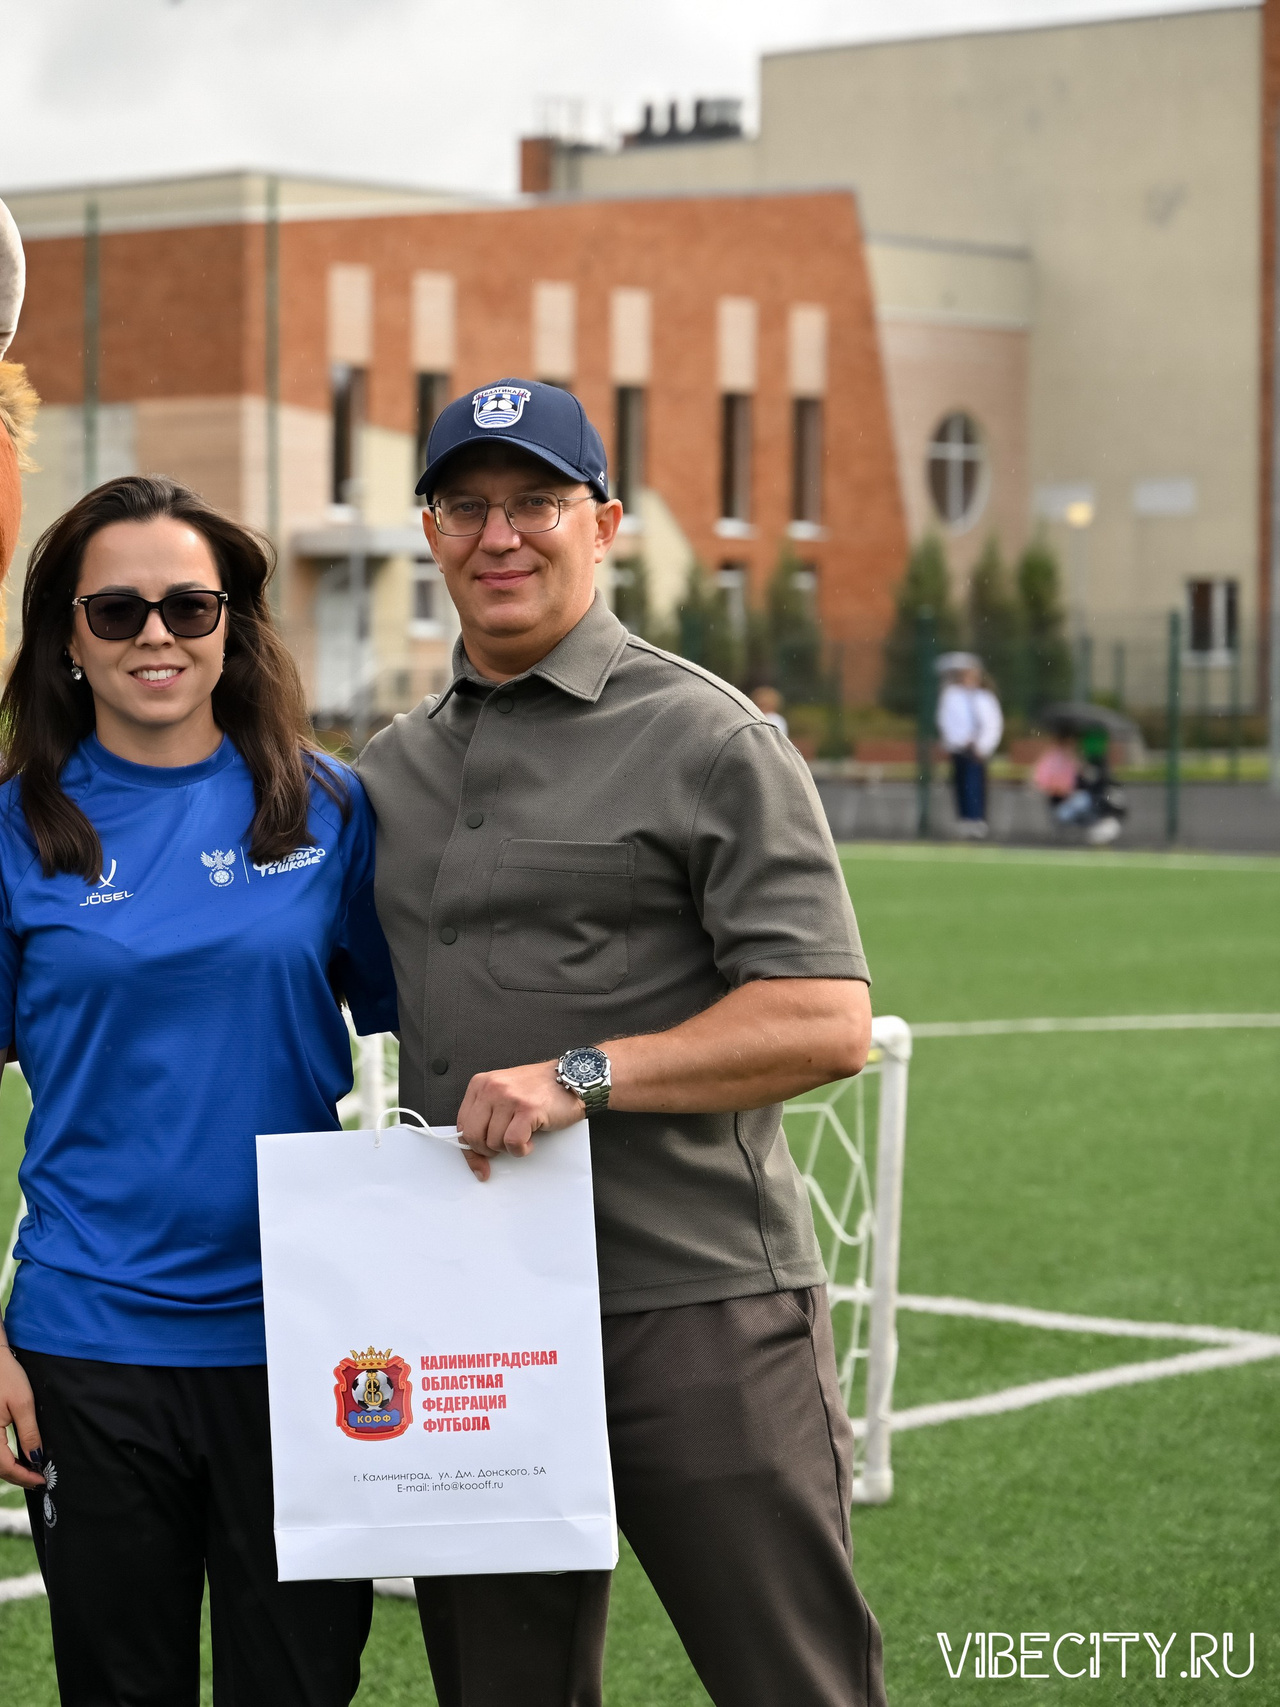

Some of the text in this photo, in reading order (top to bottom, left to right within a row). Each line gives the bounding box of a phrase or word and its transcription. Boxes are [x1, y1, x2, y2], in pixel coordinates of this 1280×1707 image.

[277, 855, 321, 874] ШКОЛЕ
[79, 890, 134, 907] JÖGEL
[420, 1350, 558, 1371] КАЛИНИНГРАДСКАЯ
[421, 1373, 504, 1391] ОБЛАСТНАЯ
[422, 1394, 507, 1413] ФЕДЕРАЦИЯ
[357, 1414, 392, 1424] КОФФ
[423, 1416, 491, 1433] ФУТБОЛА
[438, 1471, 453, 1480] ул.
[455, 1469, 475, 1479] Дм.
[533, 1466, 547, 1475] 5А
[397, 1479, 504, 1493] E-mail: info@koooff.ru
